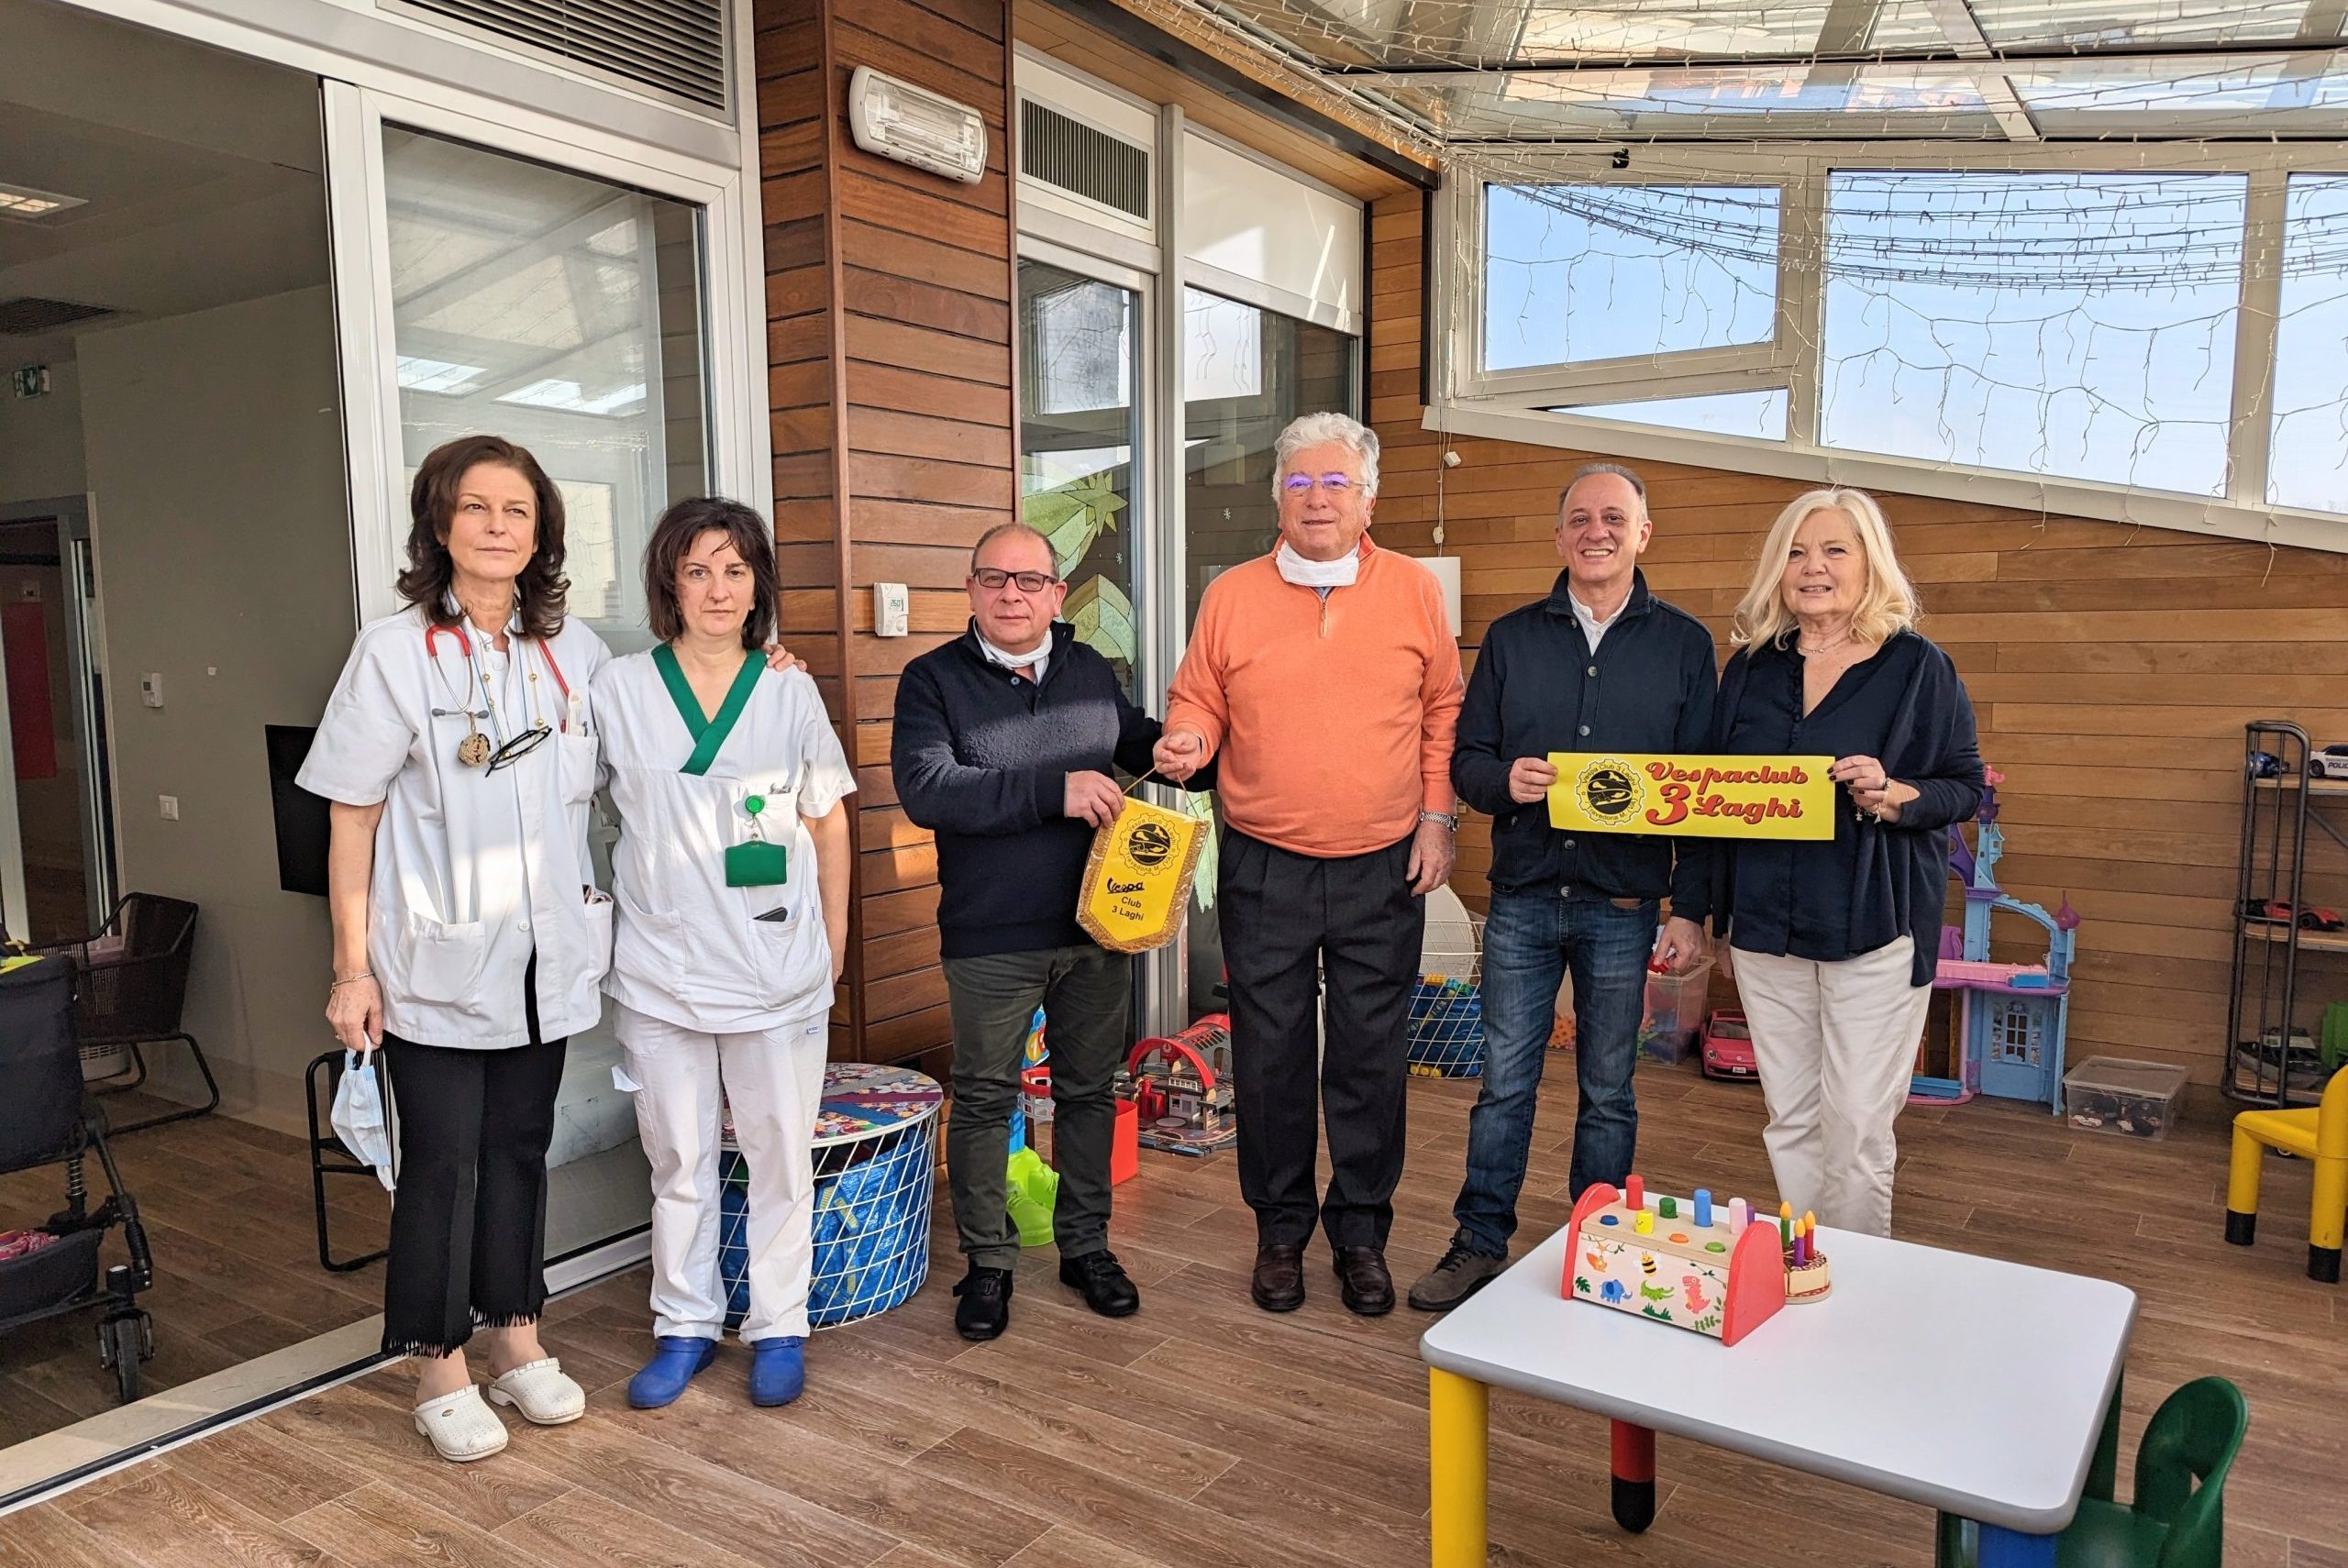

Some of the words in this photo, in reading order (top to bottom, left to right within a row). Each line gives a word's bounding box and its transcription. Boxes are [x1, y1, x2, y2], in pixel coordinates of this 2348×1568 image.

[1582, 767, 1599, 784] Vespa
[1622, 768, 1637, 786] Laghi
[1645, 761, 1809, 795] Vespaclub
[1587, 802, 1619, 820] Travedona
[1645, 783, 1691, 826] 3
[1692, 794, 1803, 824] Laghi
[1107, 878, 1145, 894] Vespa
[1121, 896, 1142, 908] Club
[1112, 905, 1118, 913] 3
[1119, 907, 1145, 921] Laghi
